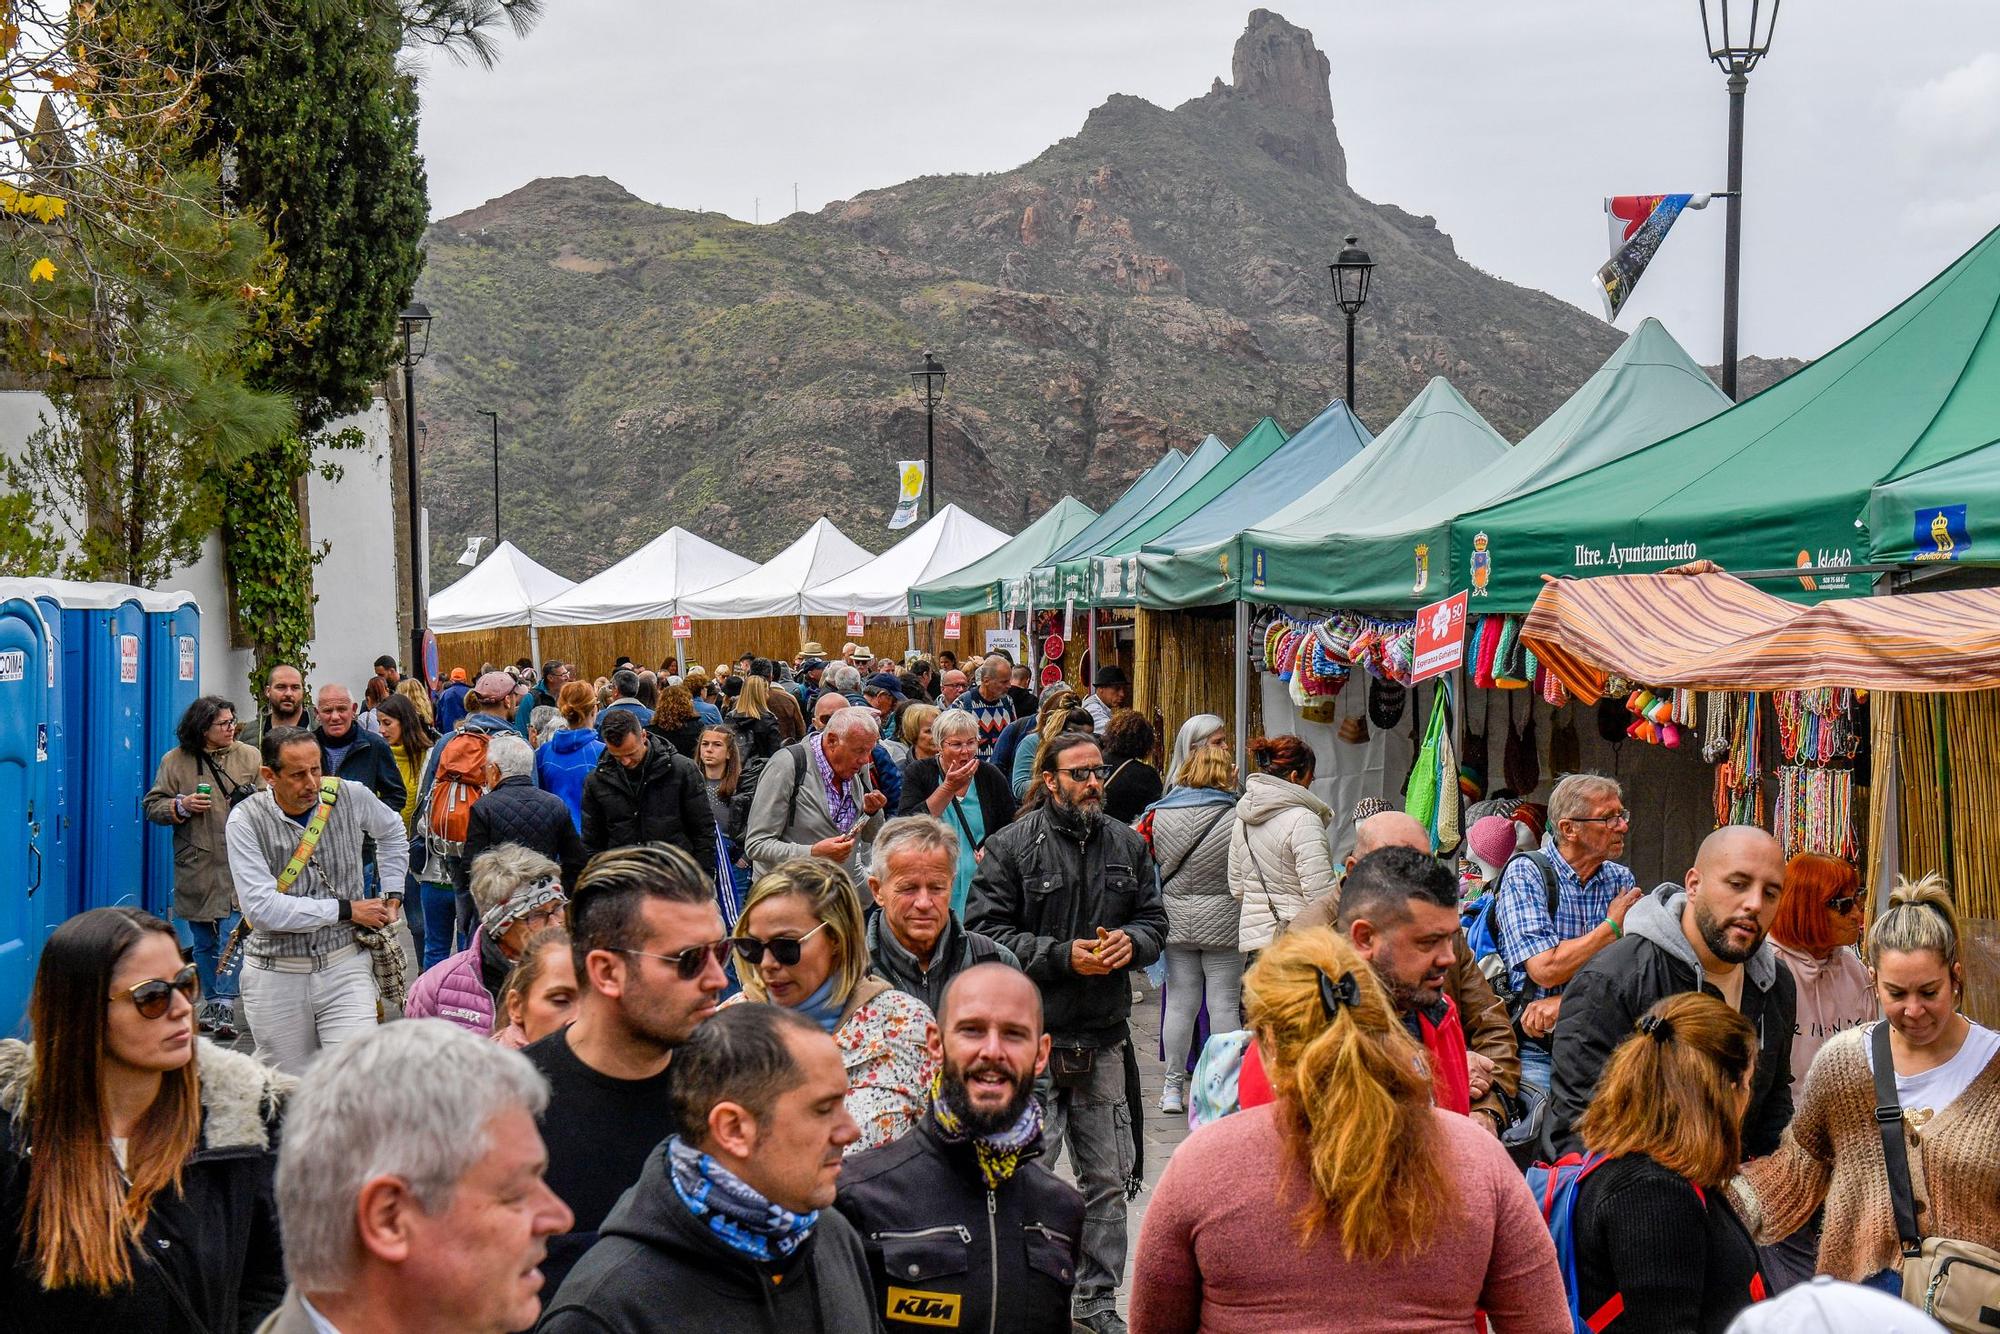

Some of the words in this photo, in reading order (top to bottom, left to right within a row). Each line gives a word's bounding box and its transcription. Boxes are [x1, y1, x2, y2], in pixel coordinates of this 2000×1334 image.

[1574, 544, 1604, 566] Iltre.
[1607, 538, 1697, 569] Ayuntamiento
[1452, 603, 1462, 618] 50
[893, 1296, 954, 1320] KTM
